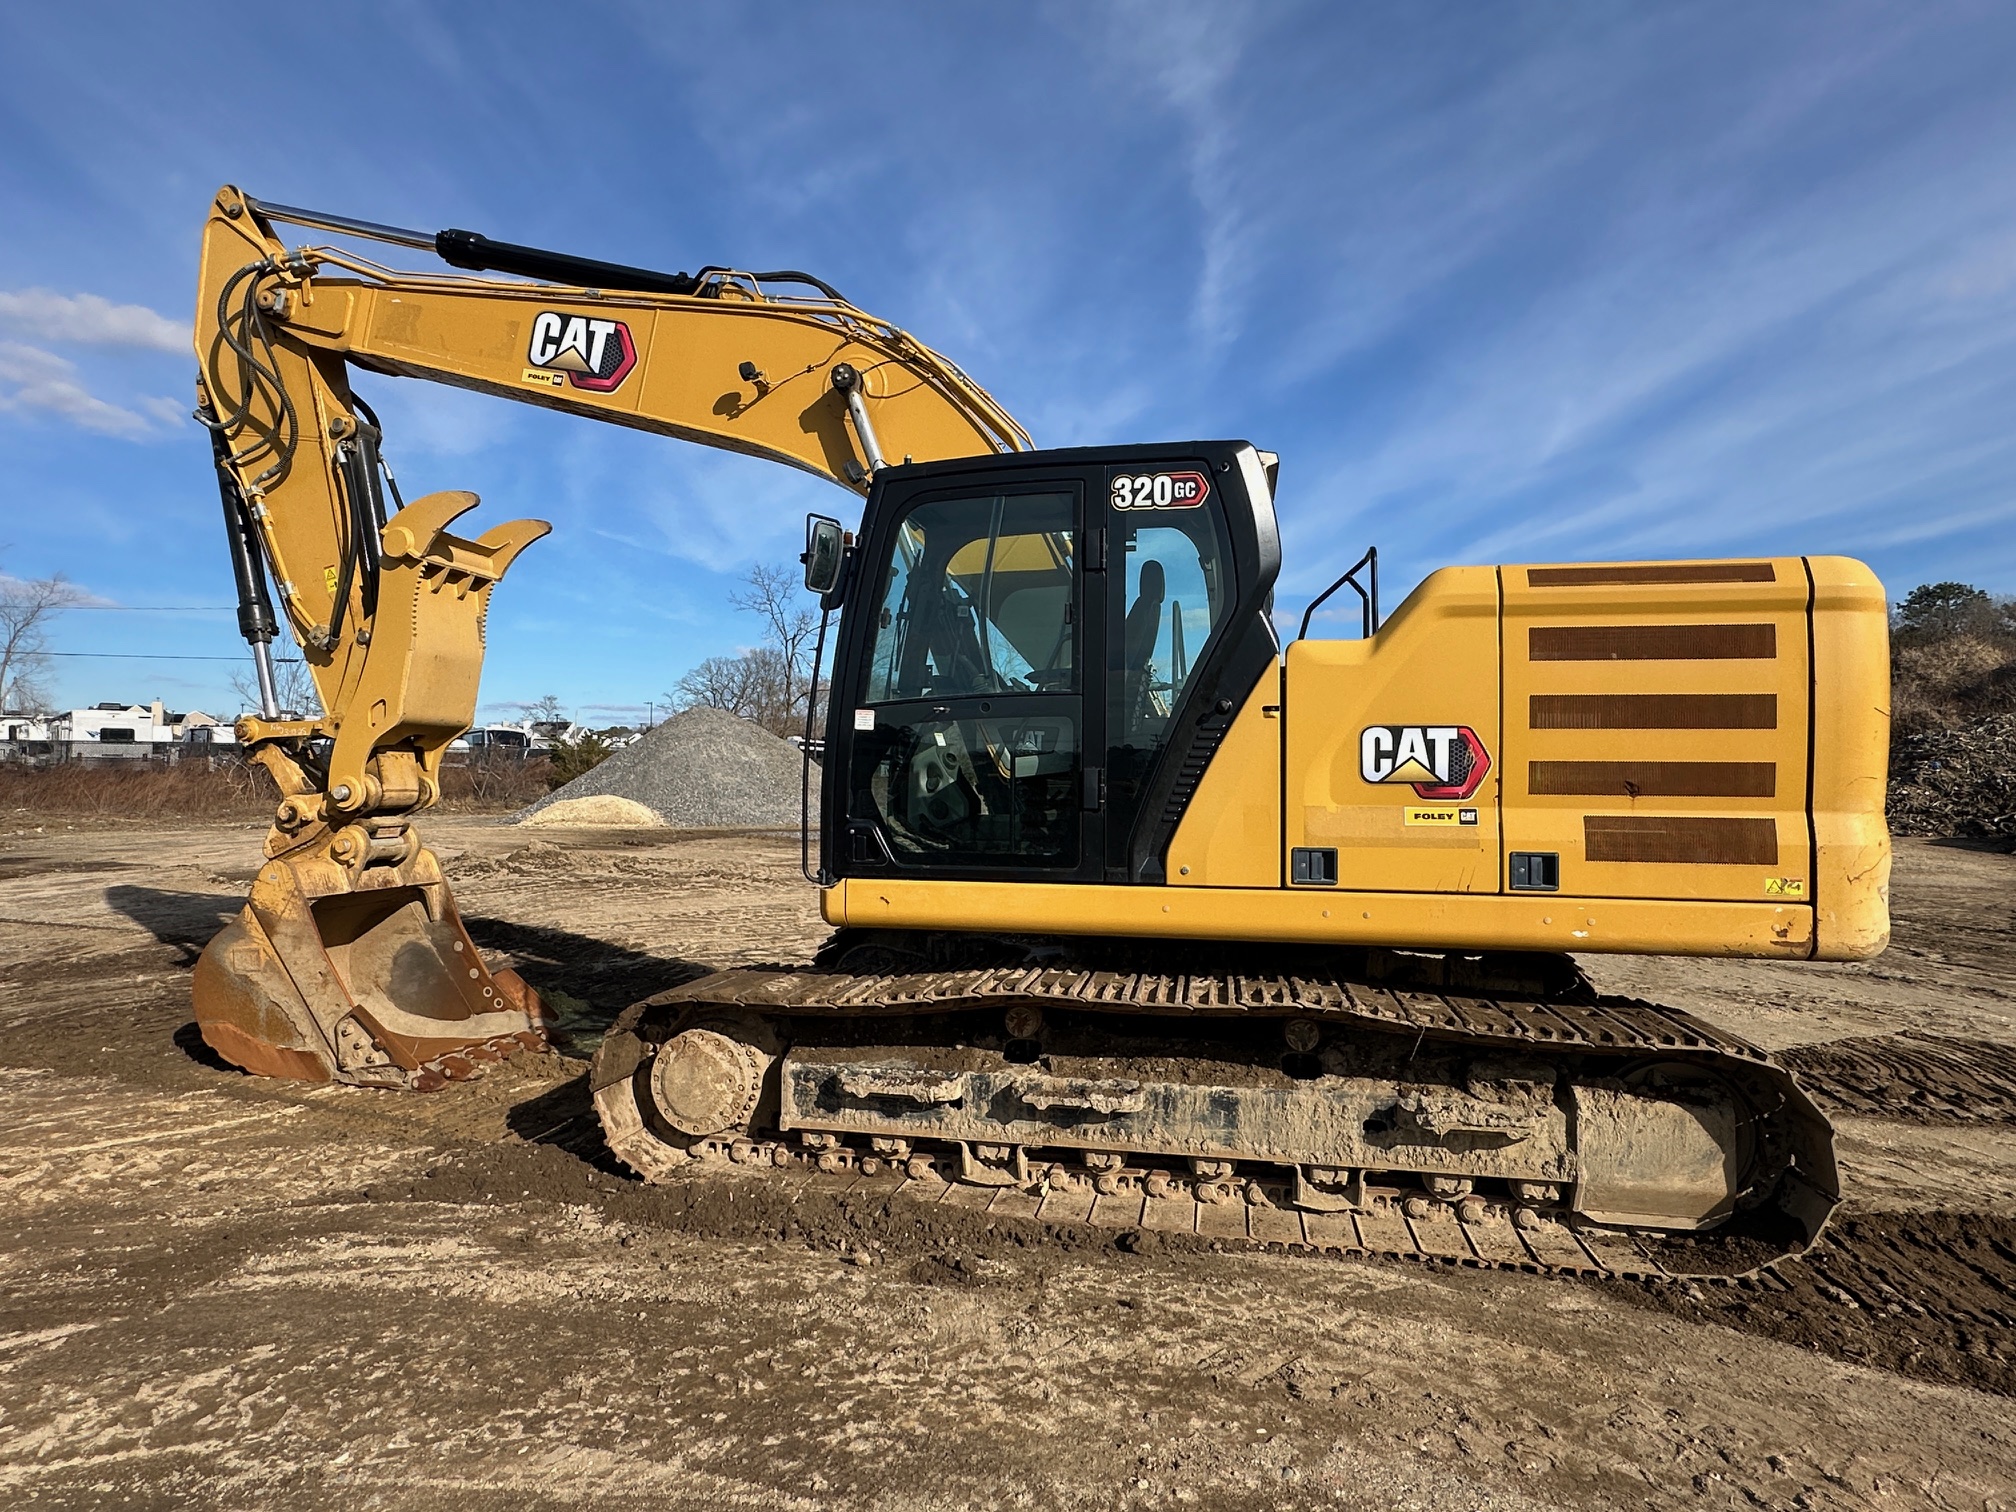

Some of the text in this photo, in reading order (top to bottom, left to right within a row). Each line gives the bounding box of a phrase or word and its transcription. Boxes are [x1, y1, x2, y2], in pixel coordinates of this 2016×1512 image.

[530, 312, 616, 374] CAT
[528, 373, 550, 382] FOLEY
[1114, 475, 1196, 507] 320 GC
[1362, 726, 1458, 782] CAT
[1460, 811, 1476, 821] CAT
